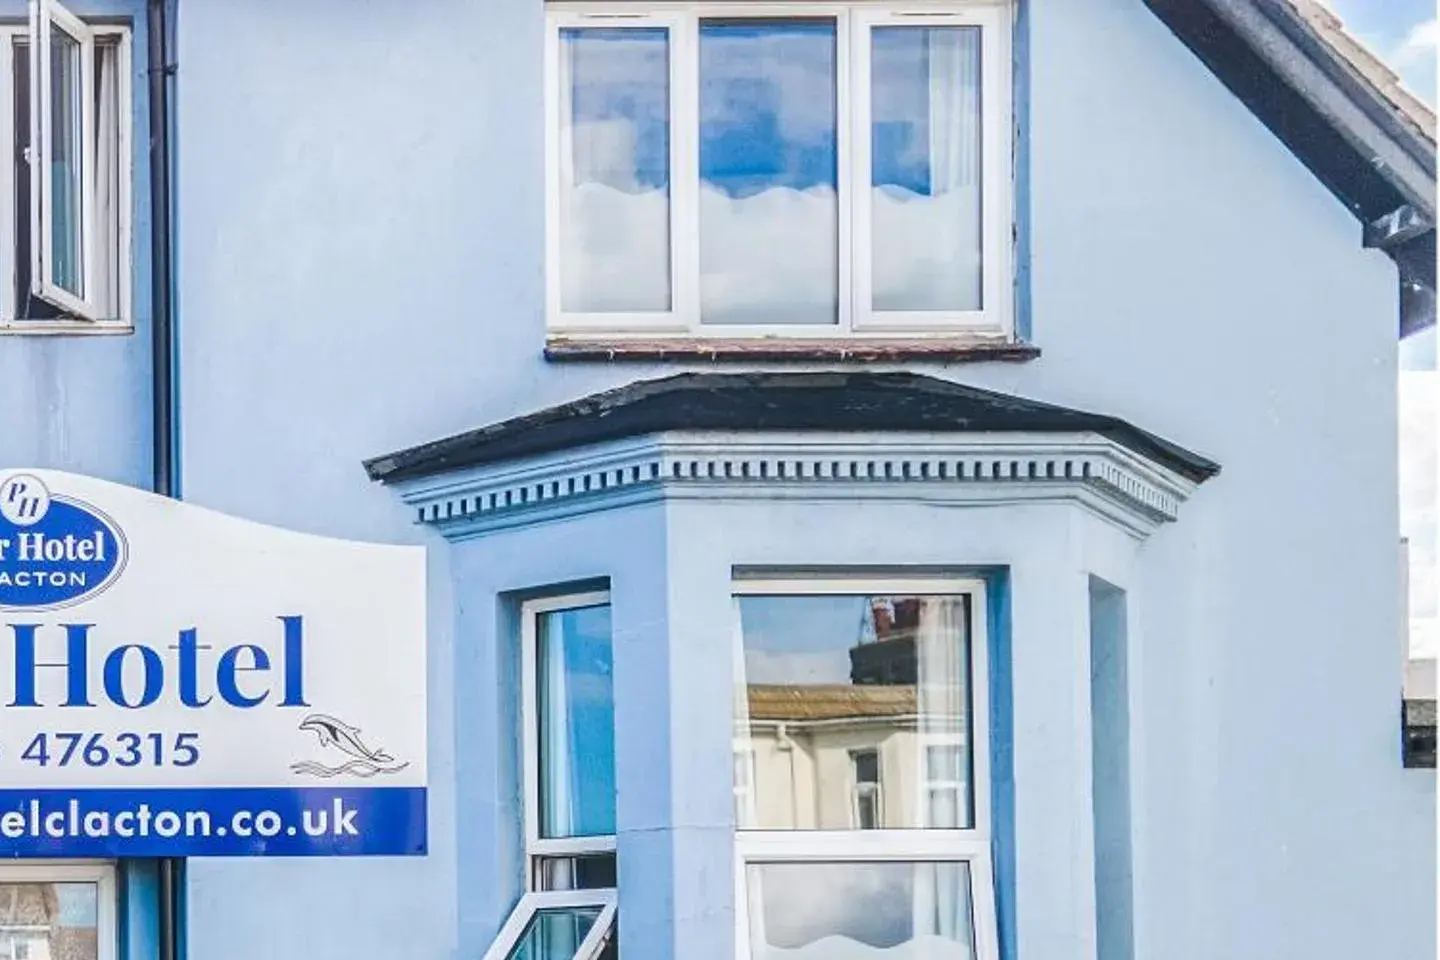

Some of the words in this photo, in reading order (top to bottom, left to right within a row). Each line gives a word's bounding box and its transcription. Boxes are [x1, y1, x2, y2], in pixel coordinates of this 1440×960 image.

[17, 531, 107, 562] Hotel
[5, 615, 312, 710] Hotel
[21, 732, 201, 768] 476315
